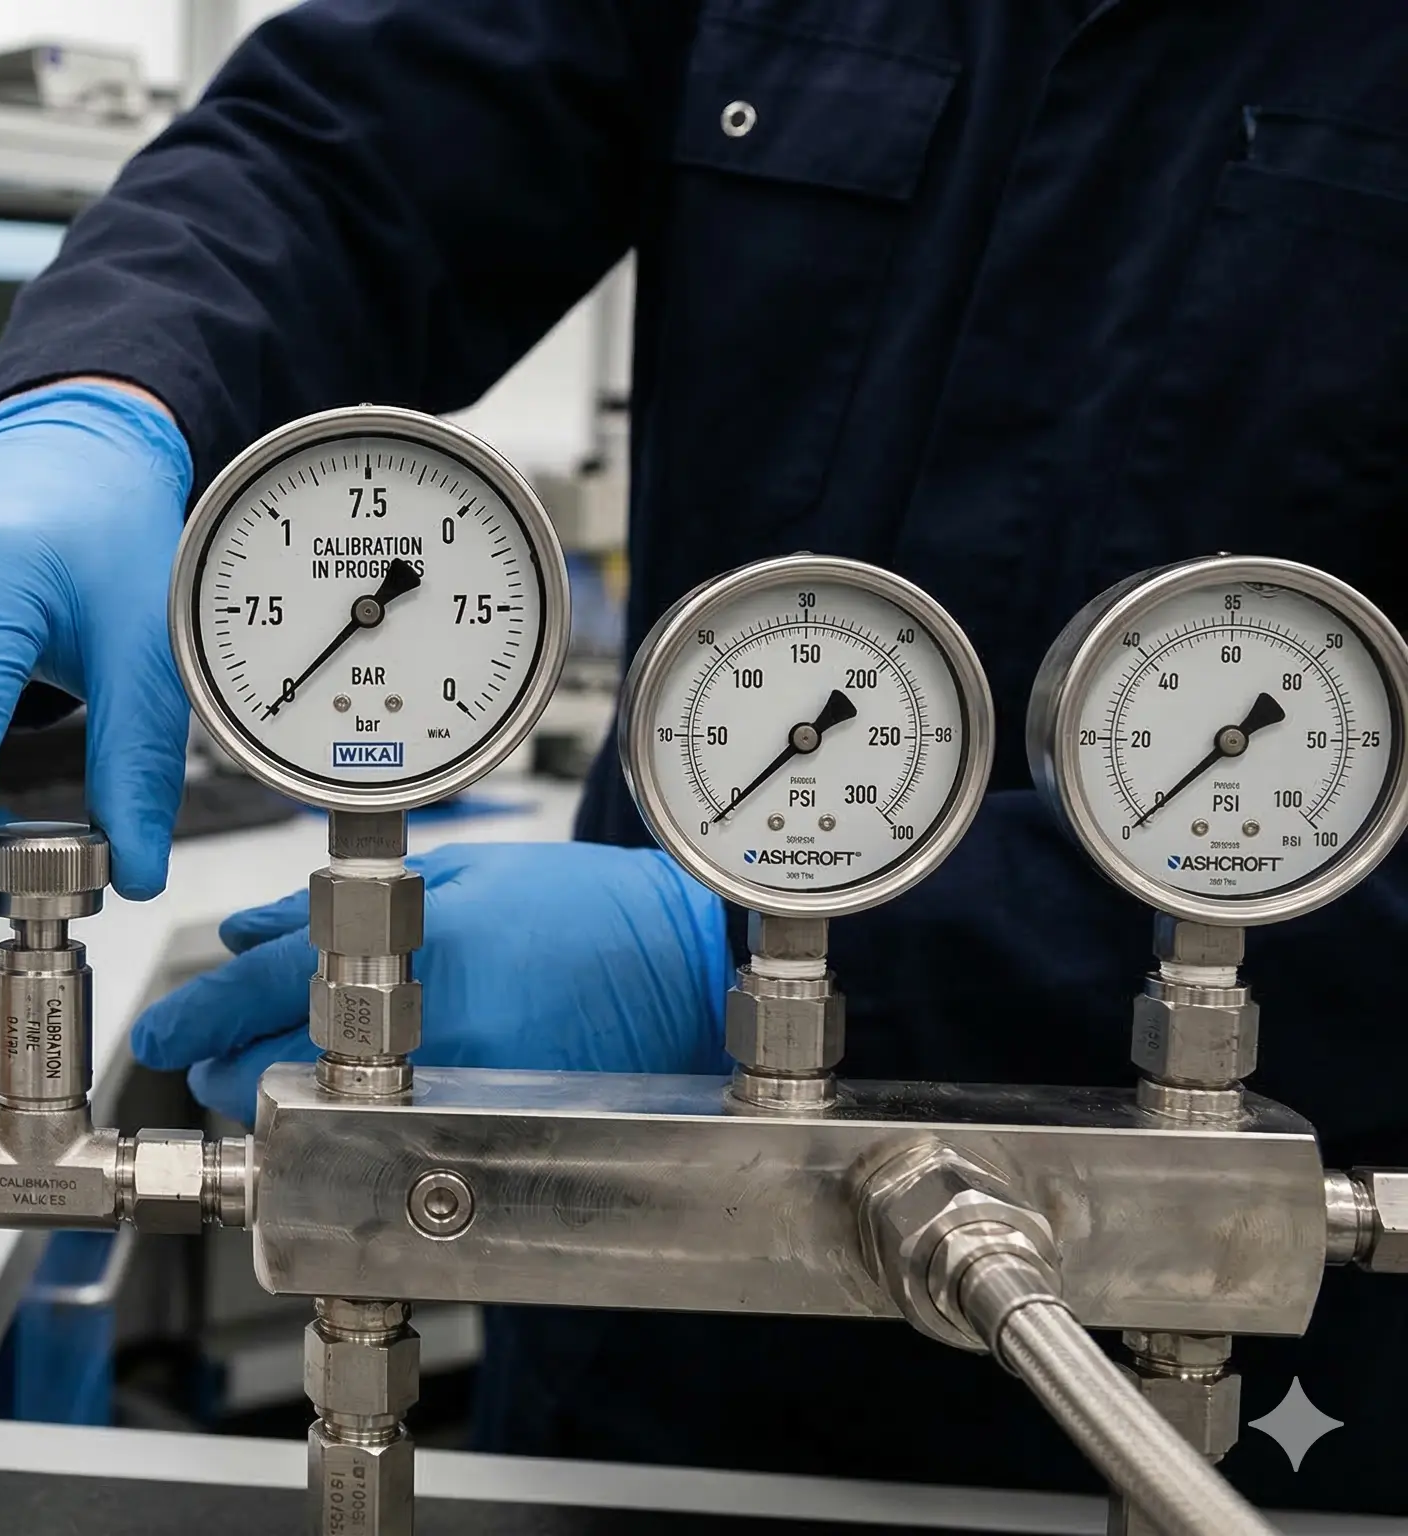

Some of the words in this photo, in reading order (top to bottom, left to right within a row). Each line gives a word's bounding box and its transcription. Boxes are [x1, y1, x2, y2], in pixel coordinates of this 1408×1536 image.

[348, 487, 388, 519] 7.5
[280, 518, 292, 546] 1
[442, 517, 455, 544] 0
[312, 536, 423, 557] CALIBRATION
[312, 560, 329, 579] IN
[334, 559, 425, 579] PROGRS
[452, 594, 492, 625] 7.5
[798, 592, 816, 608] 30
[1224, 594, 1242, 610] 85
[245, 596, 284, 626] 7.5
[697, 629, 715, 645] 50
[896, 628, 915, 645] 40
[1122, 632, 1141, 648] 40
[1325, 633, 1343, 649] 50
[790, 644, 821, 664] 150
[1220, 645, 1242, 664] 60
[351, 666, 386, 685] BAR
[732, 669, 763, 689] 100
[845, 669, 878, 689] 200
[1158, 672, 1179, 691] 40
[1281, 673, 1303, 691] 80
[355, 714, 380, 733] bar
[706, 726, 728, 746] 50
[868, 726, 901, 746] 250
[1079, 730, 1097, 745] 20
[1130, 730, 1152, 748] 20
[1306, 731, 1327, 749] 50
[1360, 731, 1380, 748] 25
[336, 745, 396, 764] WIKA
[789, 789, 816, 807] PSI
[844, 785, 877, 804] 300
[1212, 794, 1240, 813] PSI
[1273, 790, 1303, 808] 100
[700, 821, 709, 836] 0
[890, 825, 914, 841] 100
[1122, 825, 1130, 841] 0
[1313, 832, 1338, 847] 100
[757, 849, 855, 866] ASHCROFT
[1180, 855, 1283, 872] ASHCROFT
[46, 998, 63, 1080] CALIBRATION
